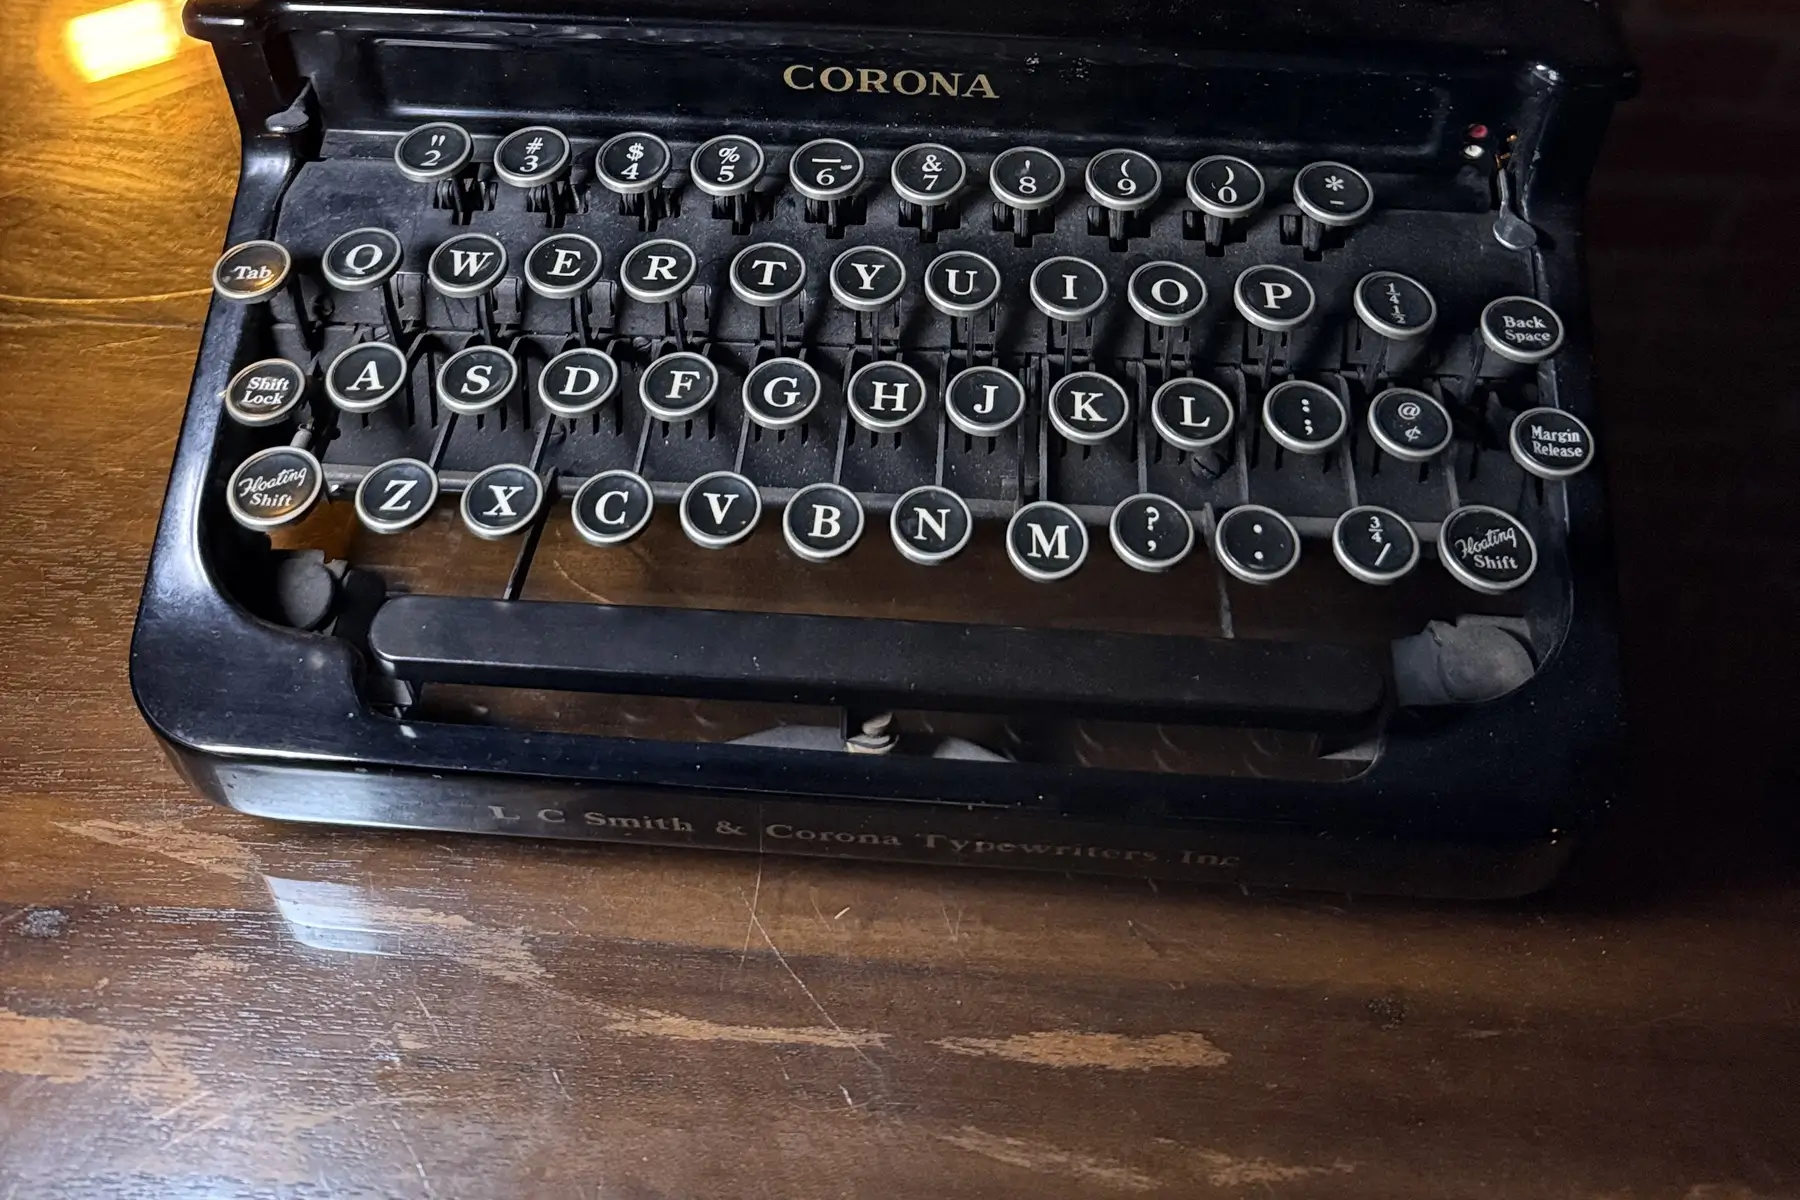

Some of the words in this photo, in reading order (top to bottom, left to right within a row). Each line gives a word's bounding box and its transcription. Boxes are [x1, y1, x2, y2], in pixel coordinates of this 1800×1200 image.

[783, 64, 999, 99] CORONA
[420, 150, 442, 167] 2
[519, 155, 539, 173] 3
[620, 162, 639, 180] 4
[716, 164, 736, 183] 5
[816, 168, 835, 186] 6
[922, 174, 939, 191] 7
[1018, 176, 1037, 195] 8
[1117, 178, 1137, 196] 9
[233, 265, 272, 281] Tab
[346, 243, 383, 274] Q
[449, 249, 494, 277] W
[547, 248, 582, 277] E
[642, 255, 678, 280] R
[752, 260, 788, 286] T
[851, 263, 885, 290] Y
[944, 268, 978, 296] U
[1061, 274, 1078, 300] I
[1151, 278, 1189, 307] O
[1259, 281, 1292, 310] P
[1503, 315, 1547, 329] Back
[1505, 329, 1551, 343] Space
[246, 376, 290, 392] Shift
[346, 360, 384, 391] A
[460, 365, 492, 395] S
[558, 366, 599, 396] D
[665, 370, 701, 399] F
[241, 390, 285, 406] Lock
[763, 376, 801, 408] G
[868, 380, 910, 412] H
[973, 385, 999, 414] J
[1070, 390, 1108, 422] K
[1178, 395, 1211, 428] L
[1530, 424, 1581, 444] Margin
[1532, 441, 1584, 458] Release
[238, 467, 308, 497] Floating
[379, 479, 418, 512] Z
[249, 493, 292, 508] Shift
[482, 484, 524, 516] X
[594, 490, 630, 525] C
[703, 492, 739, 525] V
[807, 504, 841, 539] B
[913, 507, 951, 541] N
[1027, 522, 1071, 560] M
[1455, 527, 1517, 559] Floating
[1473, 554, 1518, 570] Shift
[488, 805, 520, 821] L
[538, 808, 566, 824] C
[584, 811, 694, 833] Smith
[715, 820, 748, 836] &
[766, 823, 902, 847] Corona
[916, 833, 1158, 863] Typewriters
[1180, 850, 1241, 869] Inc
